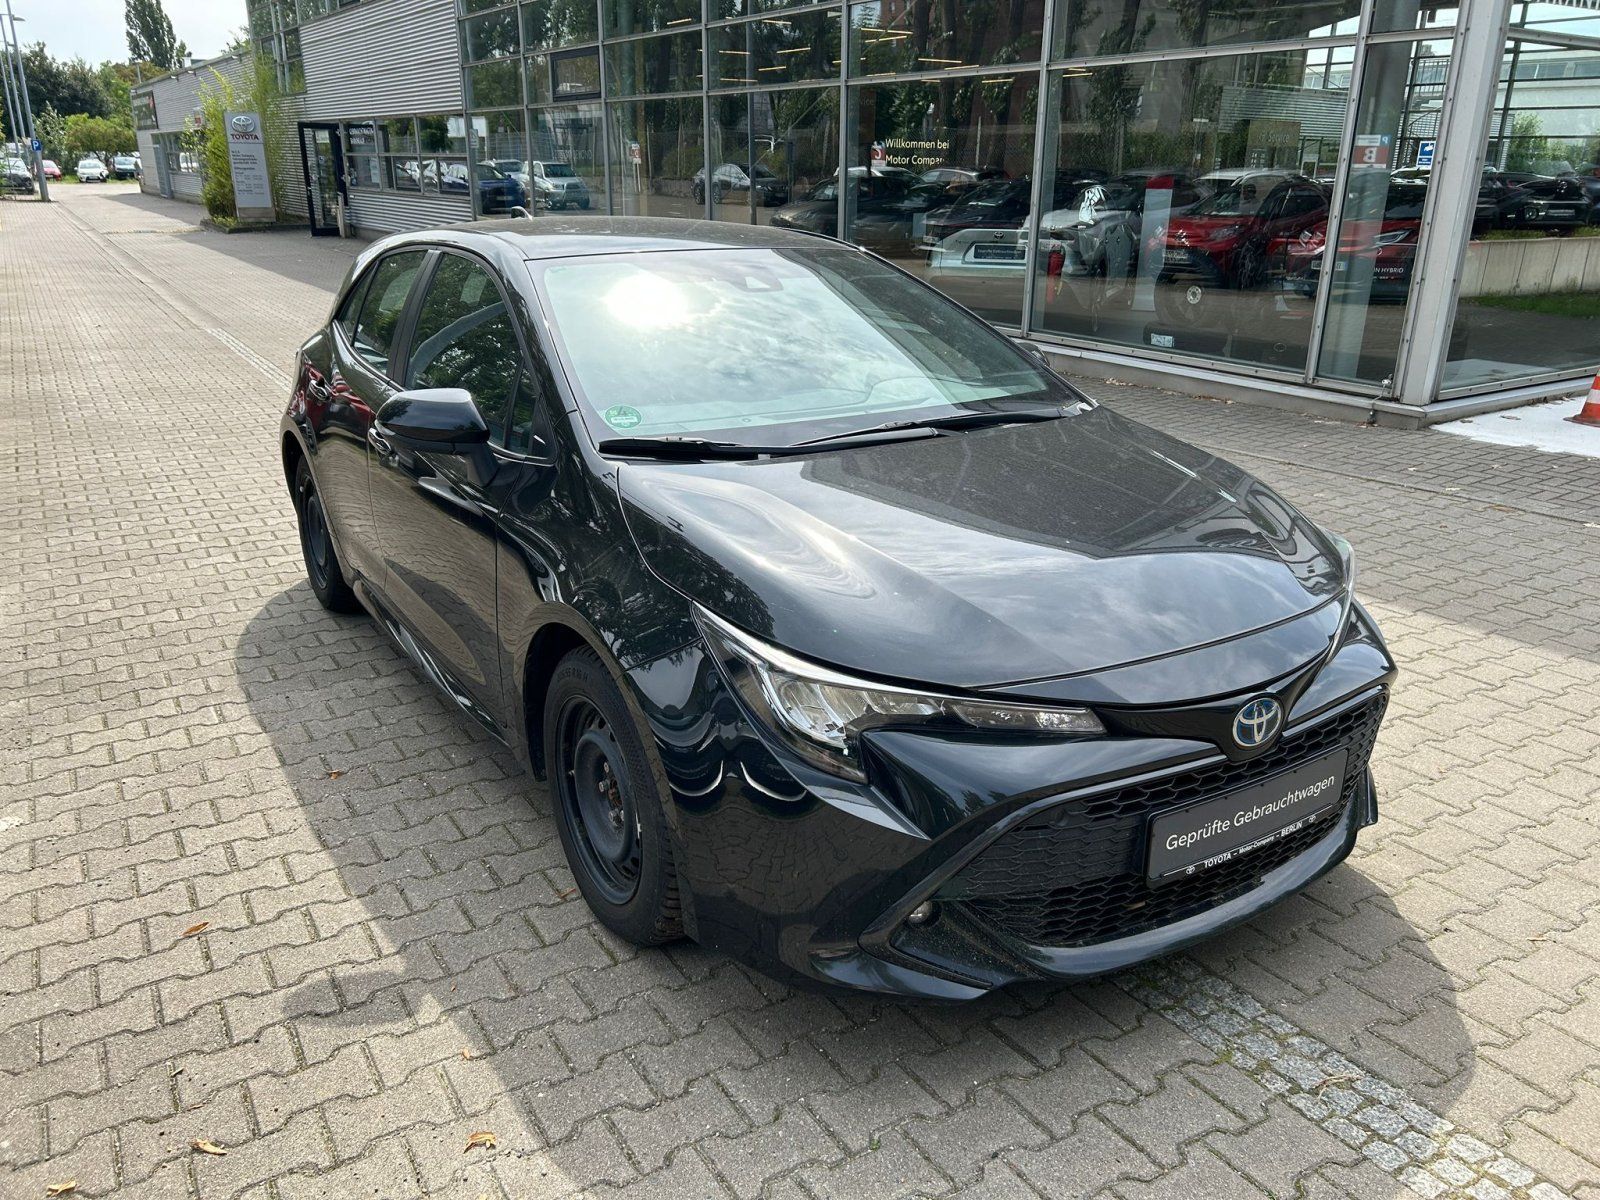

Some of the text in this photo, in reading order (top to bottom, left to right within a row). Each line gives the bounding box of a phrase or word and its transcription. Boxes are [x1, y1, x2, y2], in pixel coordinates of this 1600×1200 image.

[885, 138, 950, 149] Willkommen bei
[885, 154, 909, 164] Motor
[1165, 775, 1335, 850] Geprüfte Gebrauchtwagen
[1204, 852, 1232, 868] TOYOTA
[1238, 835, 1275, 854] Motor-Company
[1281, 821, 1303, 837] BERLIN
